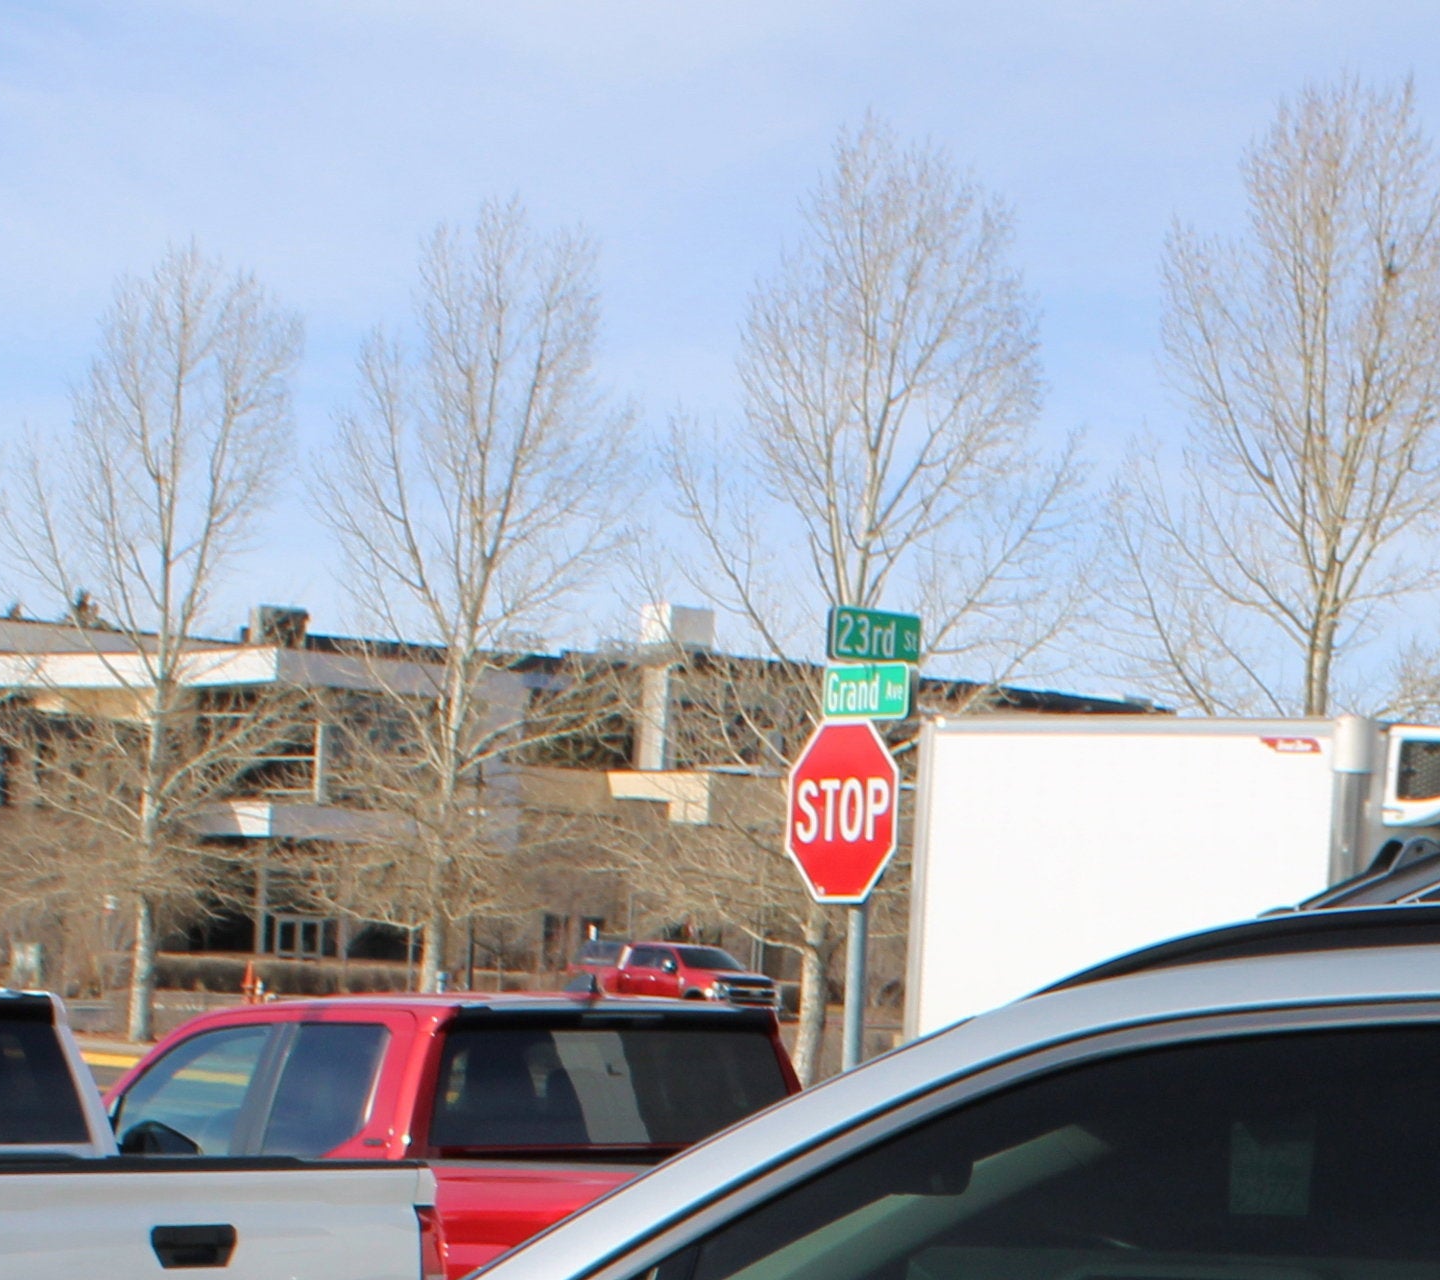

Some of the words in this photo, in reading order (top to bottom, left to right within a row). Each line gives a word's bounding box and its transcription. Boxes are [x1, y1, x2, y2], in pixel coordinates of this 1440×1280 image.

[839, 614, 896, 658] 23rd
[827, 671, 881, 713] Grand
[885, 681, 904, 700] Ave
[795, 777, 890, 843] STOP
